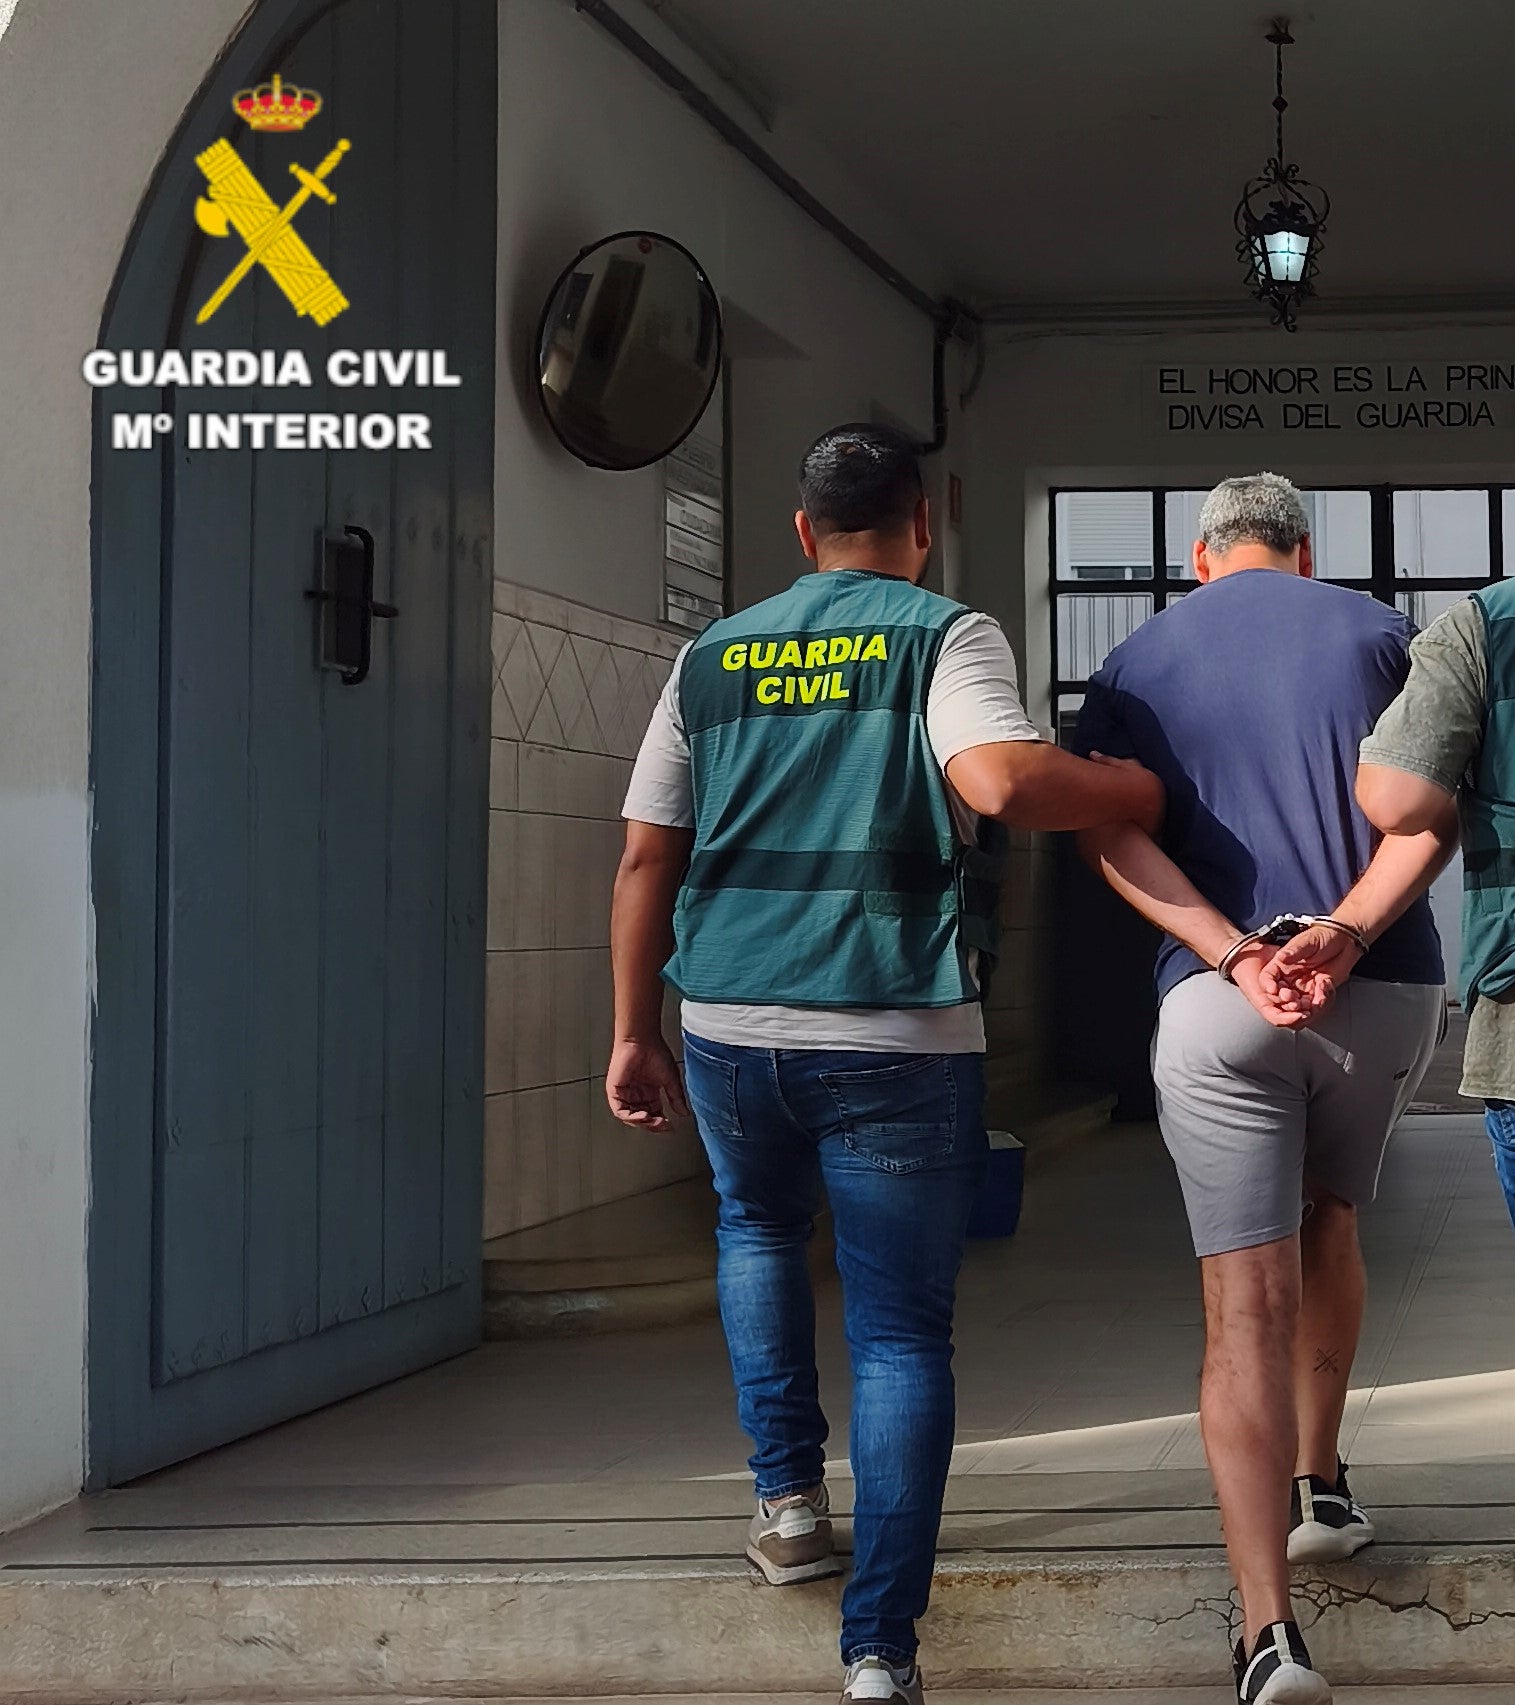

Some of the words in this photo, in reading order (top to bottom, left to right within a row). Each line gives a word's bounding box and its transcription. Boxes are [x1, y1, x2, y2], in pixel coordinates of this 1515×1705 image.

[1159, 368, 1196, 394] EL
[1208, 367, 1320, 394] HONOR
[1334, 366, 1373, 392] ES
[1387, 366, 1427, 391] LA
[1168, 404, 1264, 430] DIVISA
[1283, 403, 1341, 429] DEL
[1357, 401, 1494, 429] GUARDIA
[722, 634, 888, 671] GUARDIA
[756, 672, 849, 705] CIVIL
